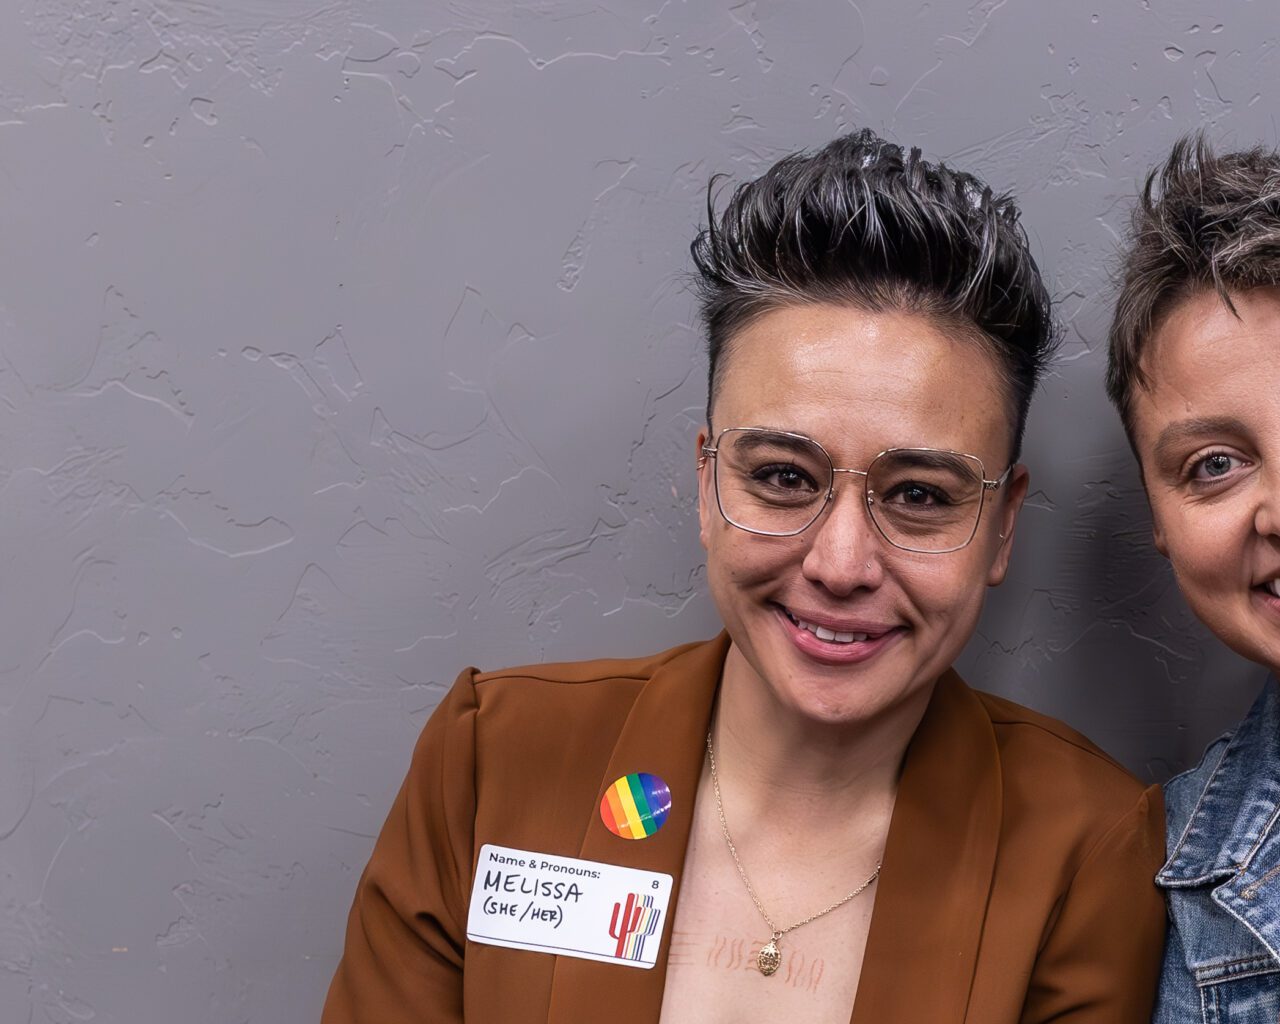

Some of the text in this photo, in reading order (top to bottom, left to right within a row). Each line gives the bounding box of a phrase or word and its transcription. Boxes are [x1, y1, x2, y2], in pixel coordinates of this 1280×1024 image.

[489, 852, 601, 879] Name & Pronouns:
[483, 870, 584, 903] MELISSA
[651, 880, 660, 890] 8
